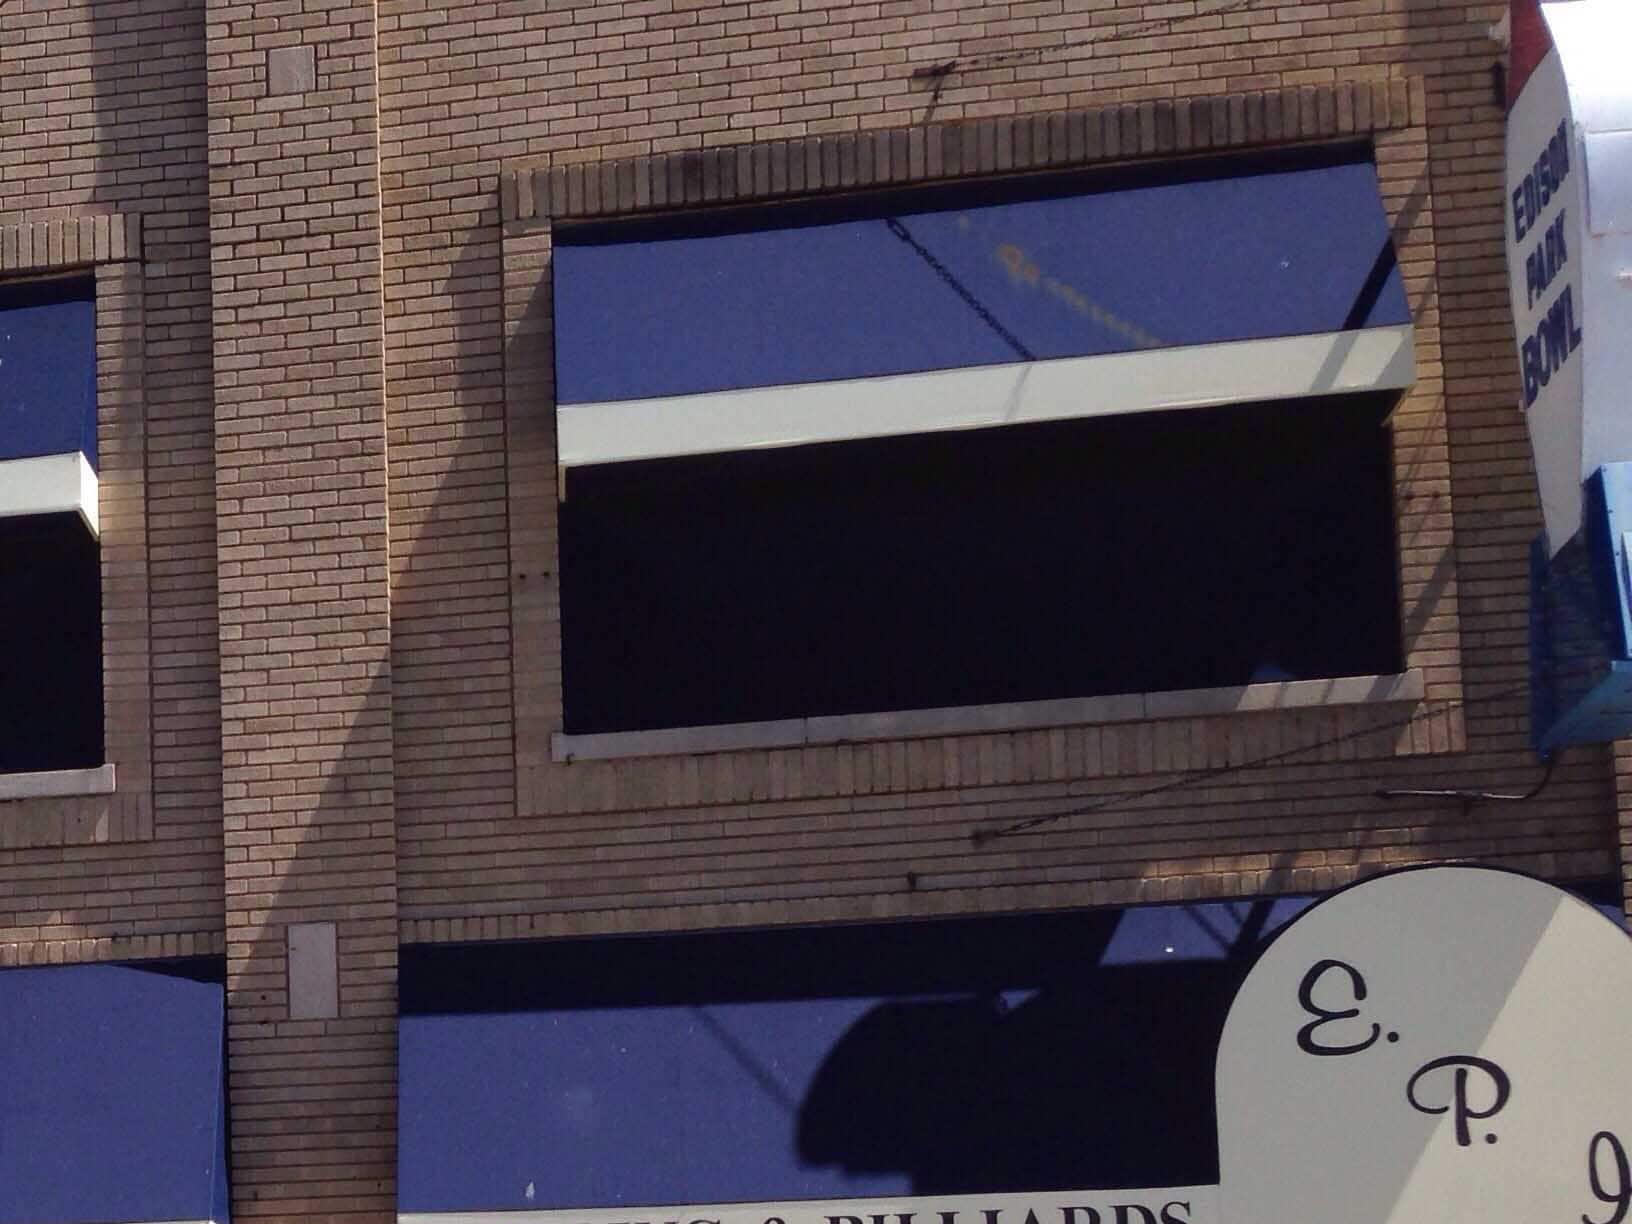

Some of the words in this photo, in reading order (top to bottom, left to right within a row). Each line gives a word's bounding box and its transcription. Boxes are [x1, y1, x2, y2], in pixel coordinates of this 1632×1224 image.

[1512, 118, 1569, 243] EDISON
[1526, 208, 1567, 311] PARK
[1522, 284, 1582, 408] BOWL
